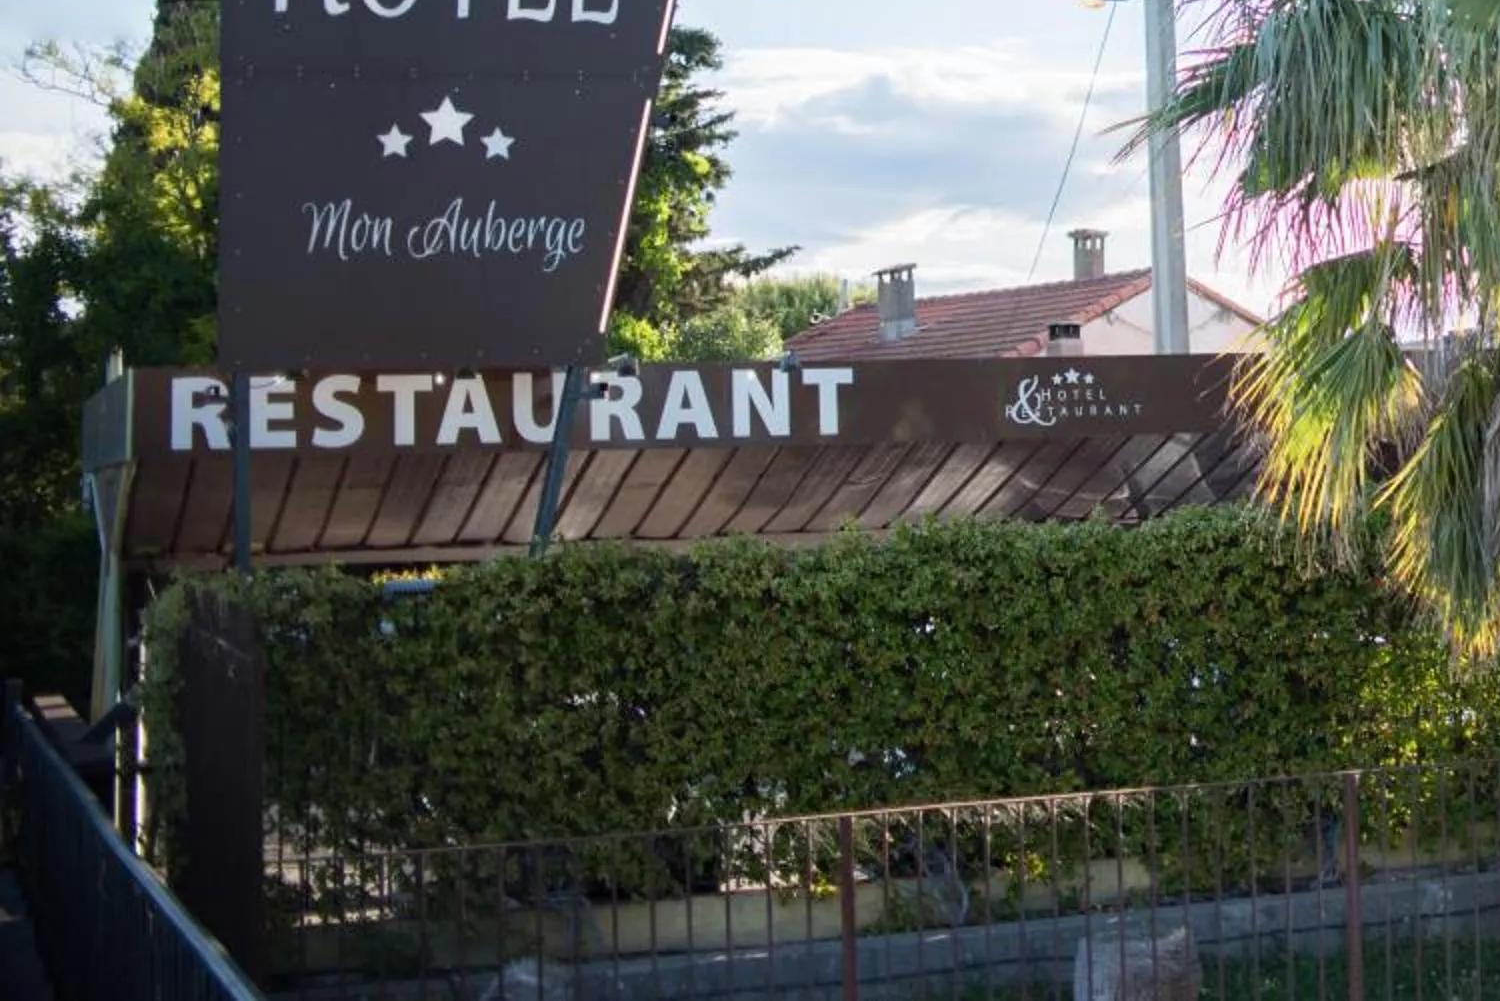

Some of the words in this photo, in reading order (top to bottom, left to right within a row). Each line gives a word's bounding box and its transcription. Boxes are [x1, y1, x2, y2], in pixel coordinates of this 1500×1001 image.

[302, 198, 392, 260] Mon
[407, 198, 585, 272] Auberge
[171, 367, 854, 450] RESTAURANT
